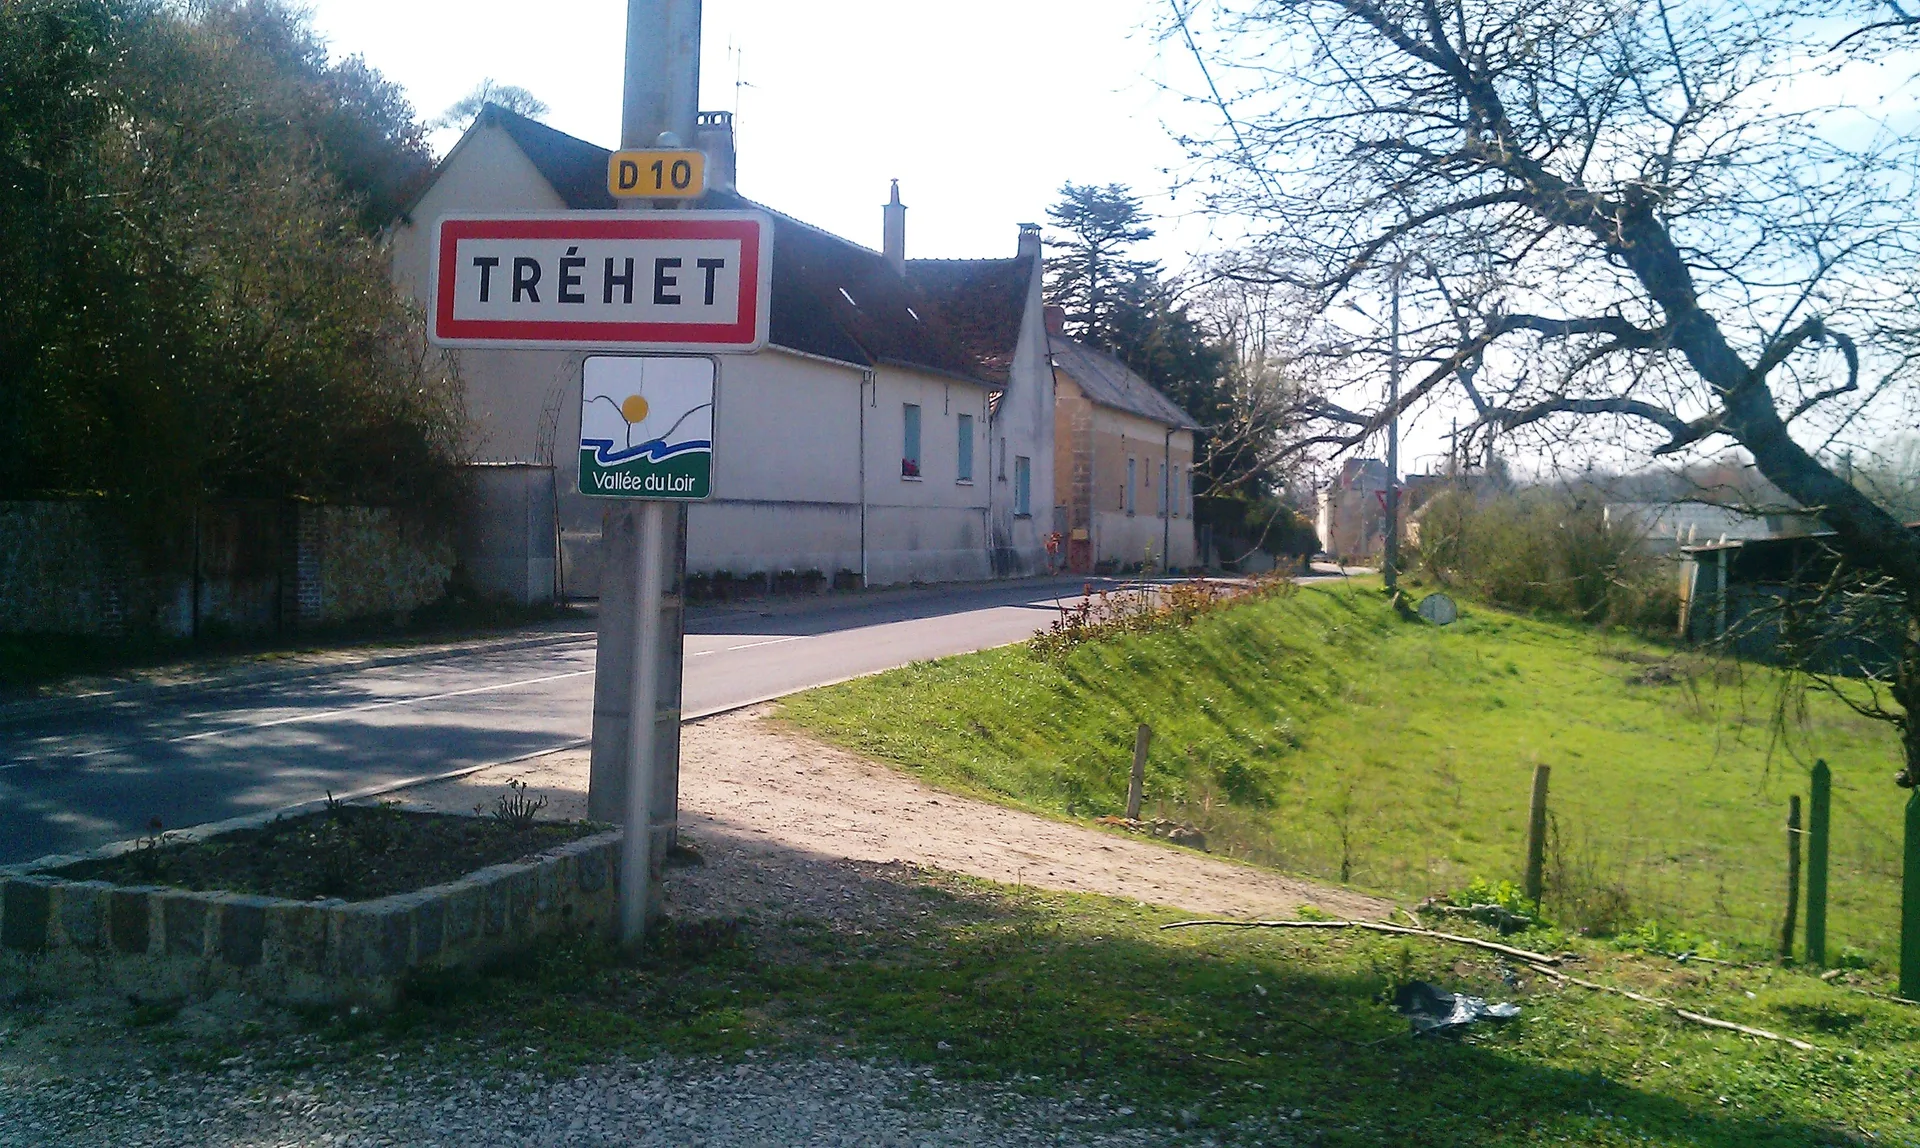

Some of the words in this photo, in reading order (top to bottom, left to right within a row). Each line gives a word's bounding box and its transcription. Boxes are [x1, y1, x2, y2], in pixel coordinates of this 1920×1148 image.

[618, 160, 639, 190] D
[650, 159, 692, 190] 10
[472, 246, 725, 306] TRÉHET
[593, 471, 641, 490] Vallée
[645, 473, 665, 491] du
[668, 474, 695, 492] Loir
